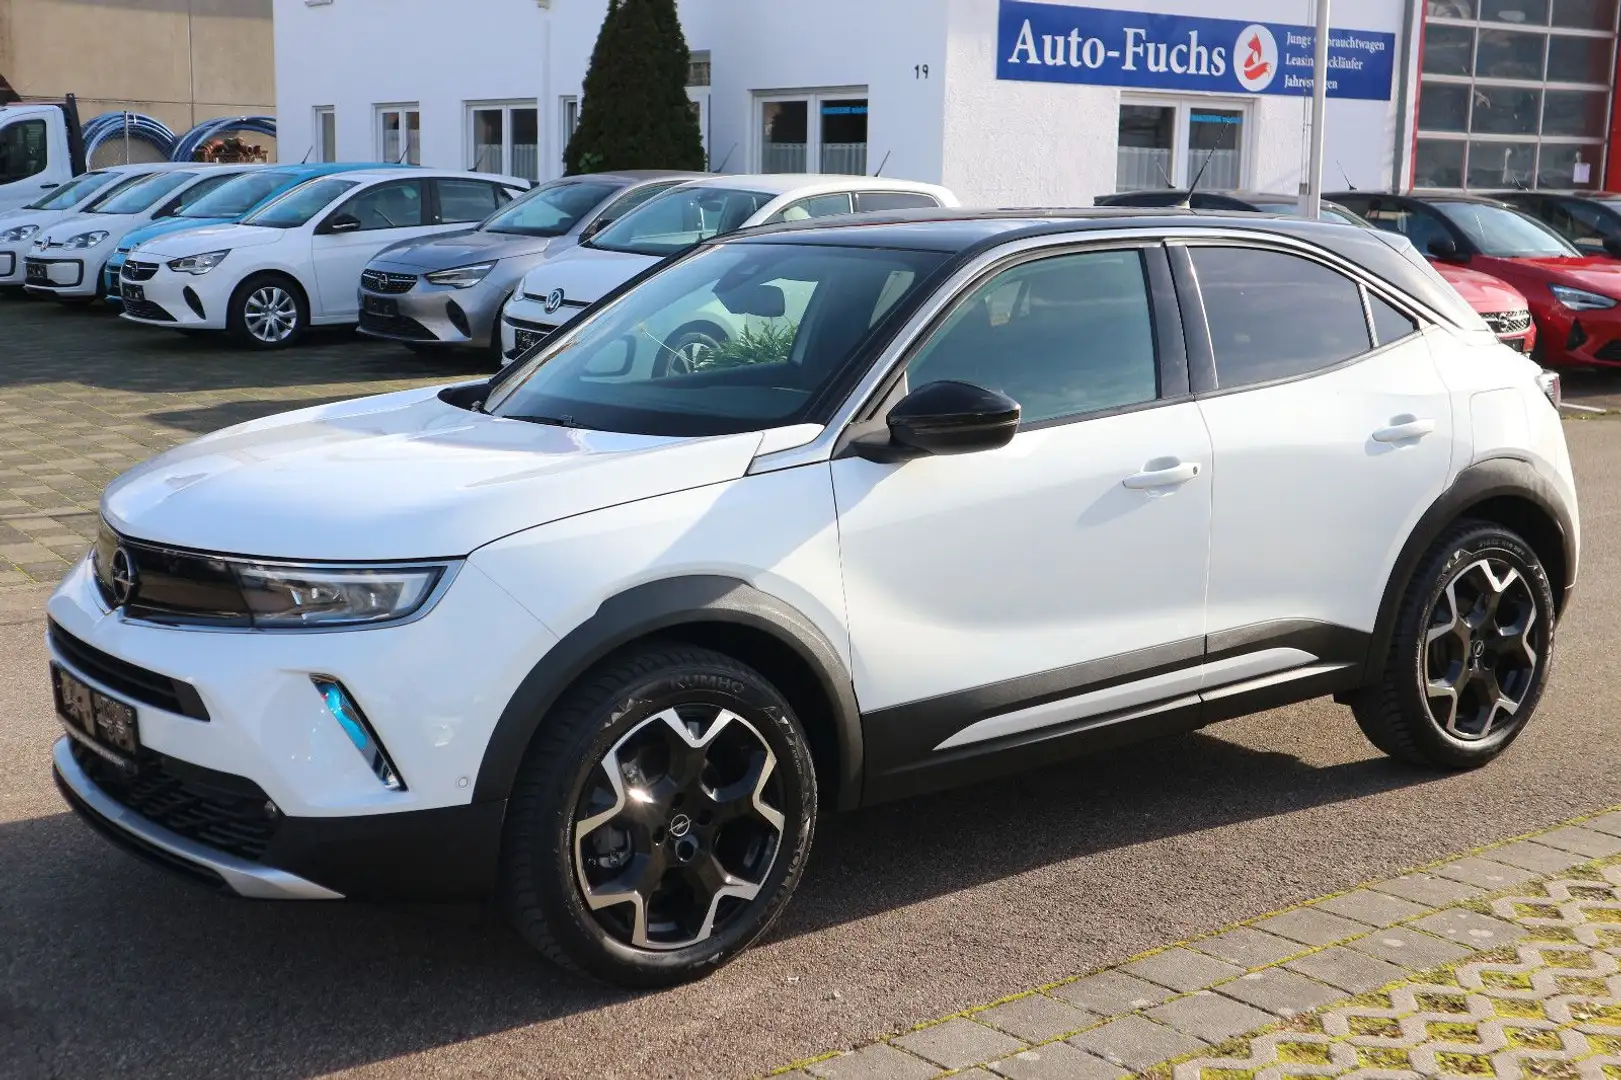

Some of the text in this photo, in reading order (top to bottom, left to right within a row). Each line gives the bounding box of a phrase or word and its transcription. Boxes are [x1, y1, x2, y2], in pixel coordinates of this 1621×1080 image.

[1007, 18, 1226, 77] Auto-Fuchs
[1286, 31, 1385, 54] Junge brauchtwagen
[914, 63, 929, 80] 19
